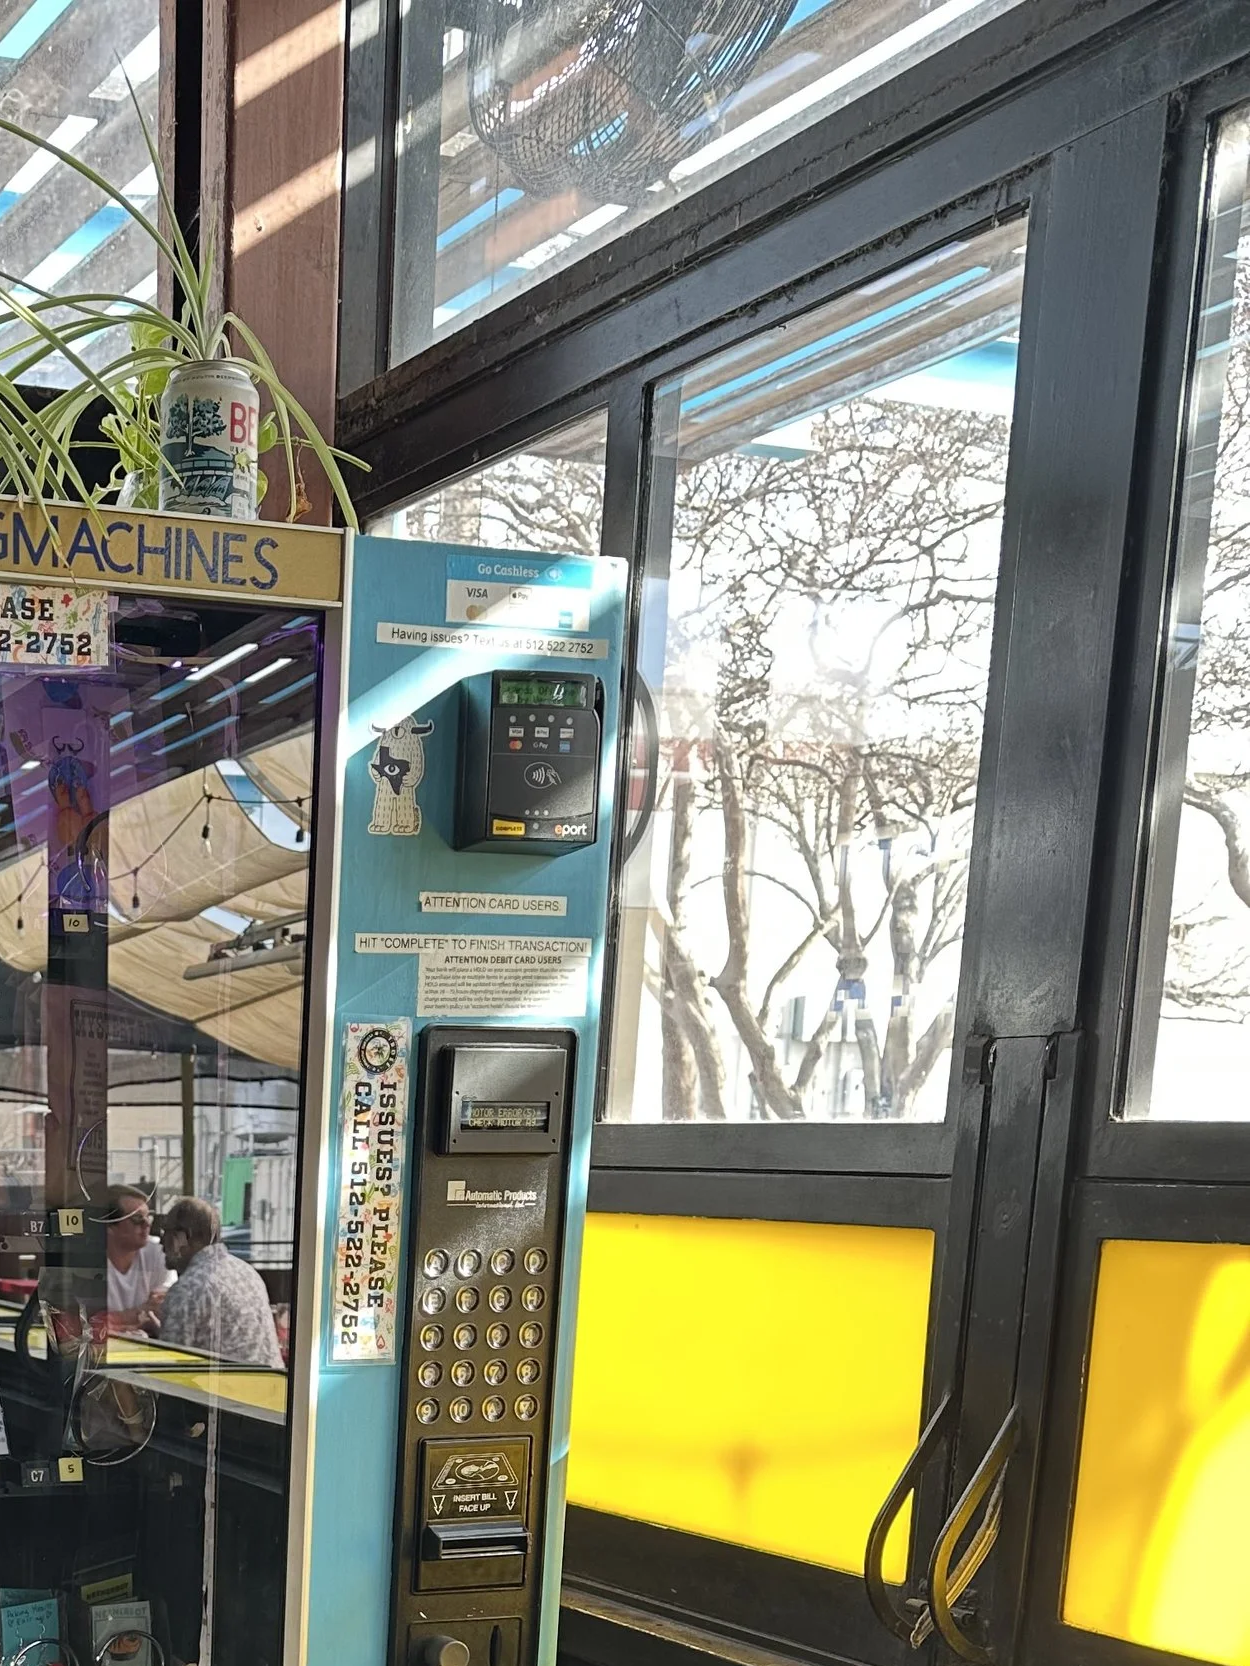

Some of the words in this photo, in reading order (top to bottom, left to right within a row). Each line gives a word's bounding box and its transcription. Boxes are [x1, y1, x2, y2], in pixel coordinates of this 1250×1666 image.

[478, 563, 492, 576] Go
[494, 565, 539, 579] Cashless
[467, 587, 489, 599] VISA
[391, 628, 427, 644] Having
[431, 632, 469, 645] issues?
[525, 639, 543, 651] 512
[547, 641, 565, 653] 522
[569, 642, 594, 655] 2752
[554, 823, 588, 838] eport
[424, 896, 486, 909] ATTENTION
[488, 898, 519, 911] CARD
[68, 917, 80, 928] 10
[359, 938, 378, 949] HIT
[380, 937, 449, 950] "COMPLETE"
[452, 939, 467, 950] TO
[470, 939, 505, 951] FINISH
[508, 941, 588, 953] TRANSACTION!
[444, 955, 488, 964] ATTENTION
[490, 956, 513, 964] DEBIT
[514, 956, 536, 965] CARD
[537, 956, 562, 965] USERS
[352, 1081, 372, 1151] CALL
[496, 1118, 519, 1127] MOTOR
[373, 1081, 398, 1197] ISSUES?
[465, 1189, 503, 1202] Automatic
[503, 1189, 538, 1201] Products
[30, 1220, 44, 1233] B7
[65, 1214, 79, 1227] 10
[340, 1161, 369, 1345] 512-522-2752
[367, 1206, 391, 1309] PLEASE
[67, 1463, 75, 1474] 5
[30, 1470, 45, 1483] C7
[452, 1492, 480, 1504] INSERT
[481, 1492, 498, 1502] BILL
[458, 1503, 478, 1513] FACE
[479, 1502, 491, 1512] UP
